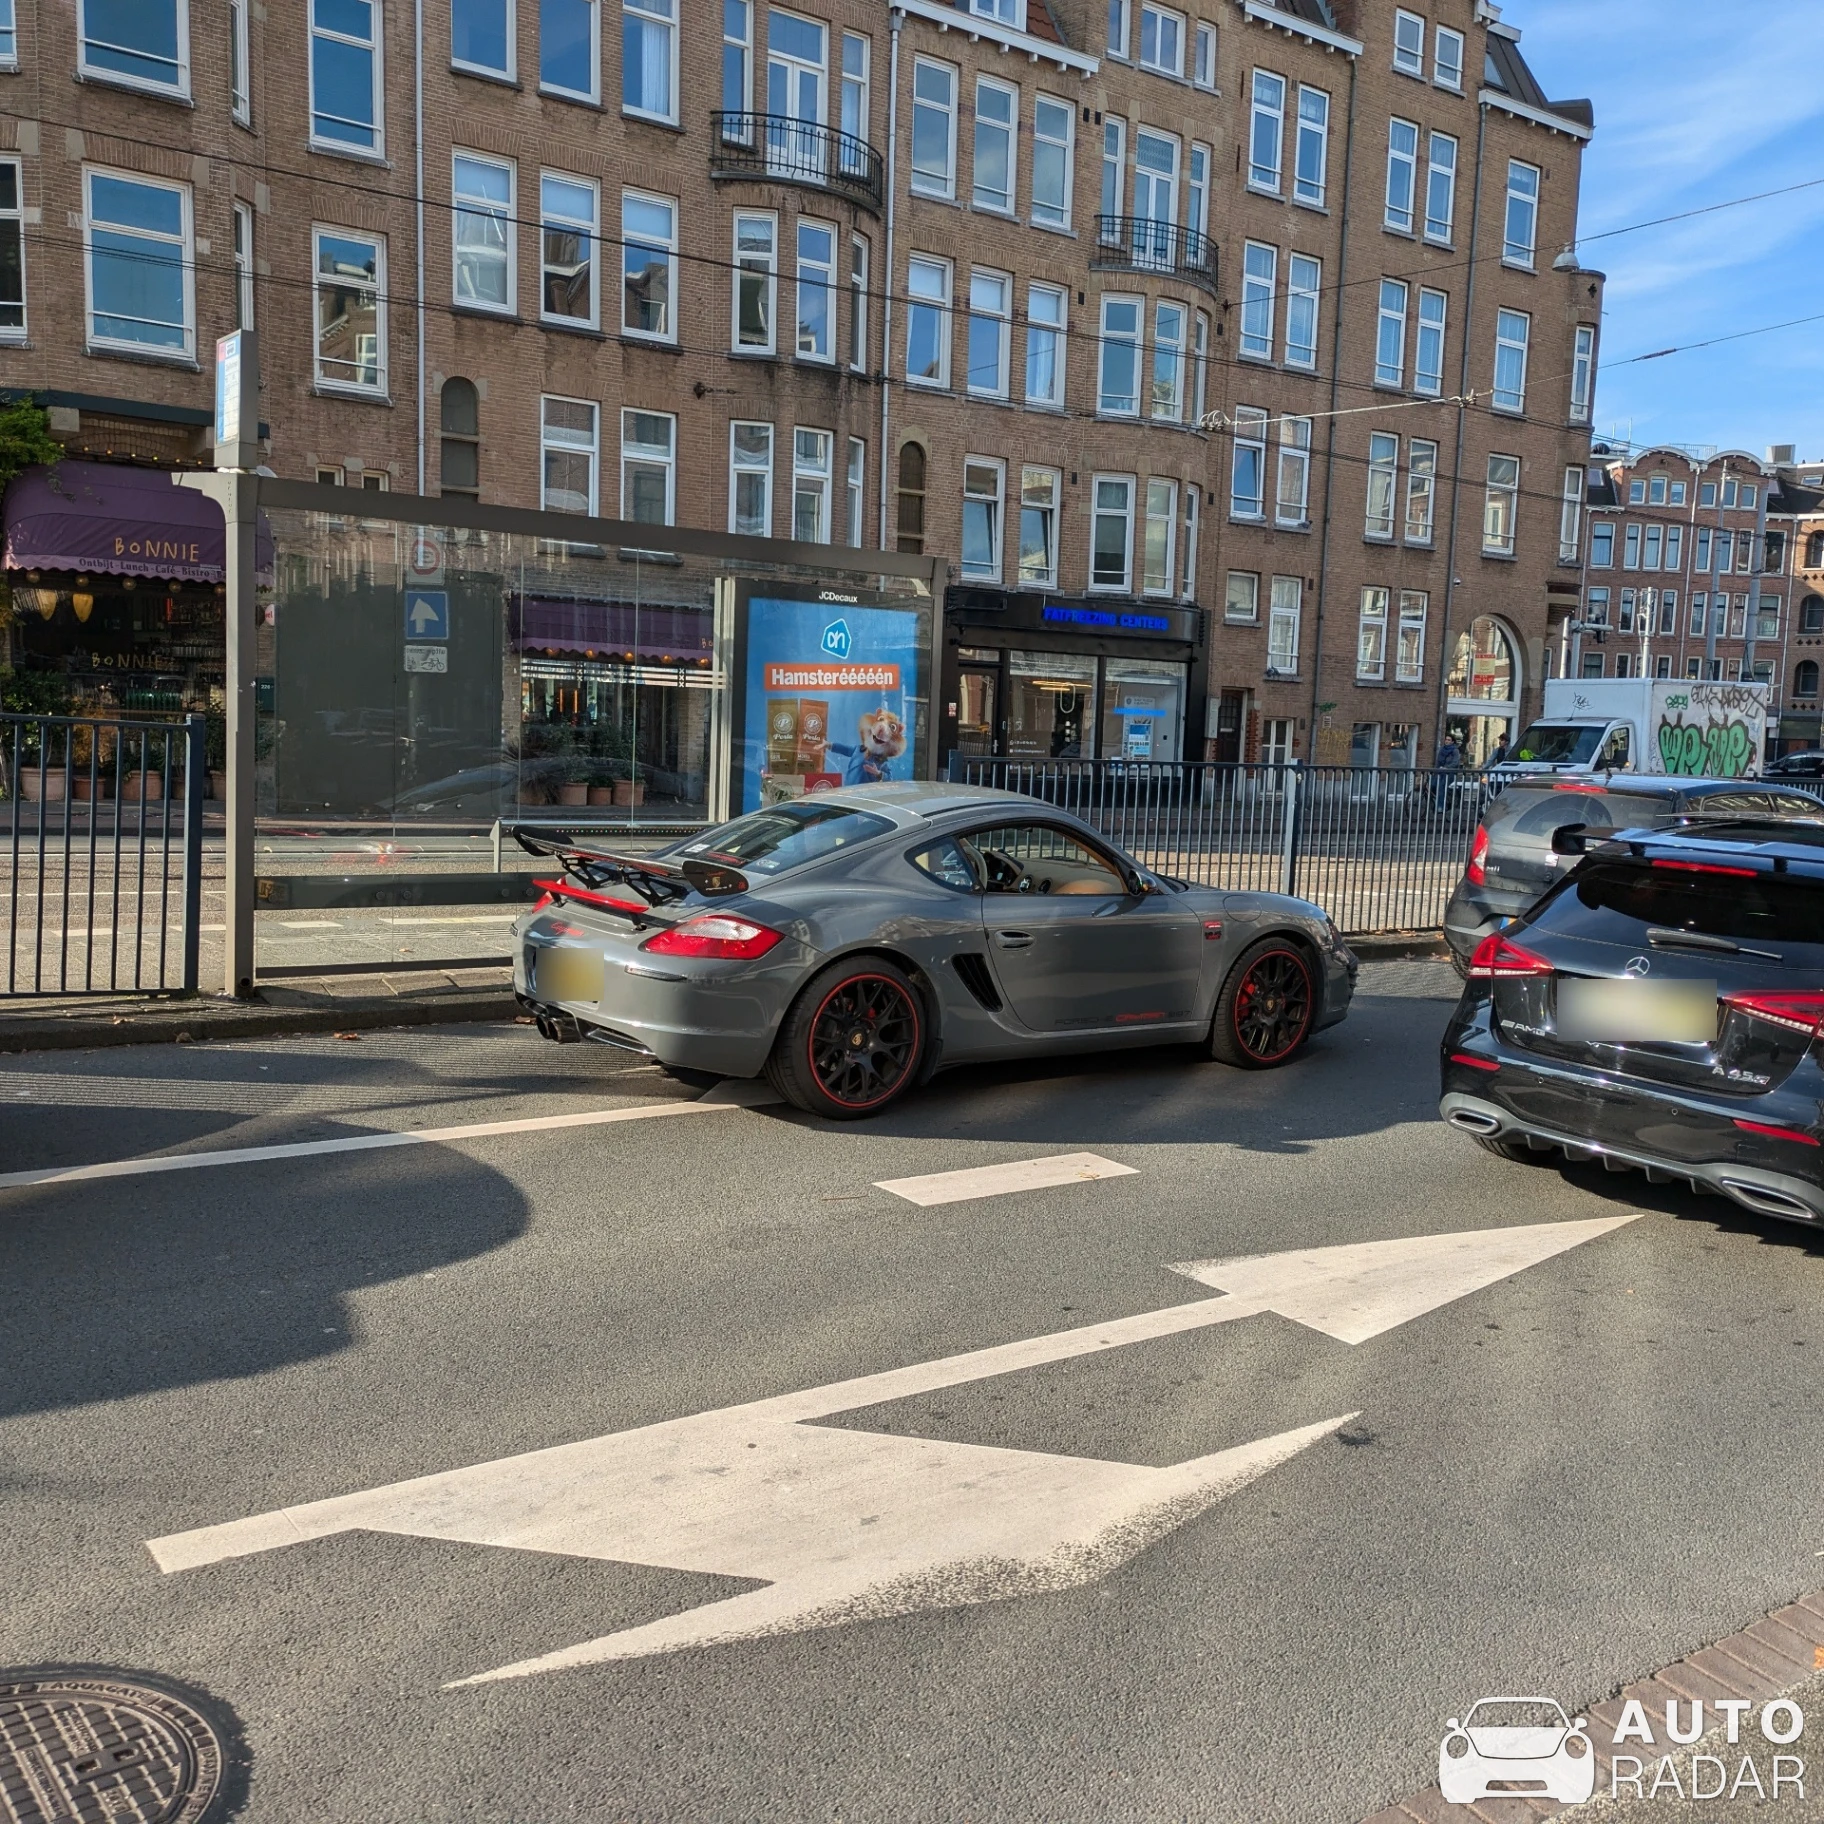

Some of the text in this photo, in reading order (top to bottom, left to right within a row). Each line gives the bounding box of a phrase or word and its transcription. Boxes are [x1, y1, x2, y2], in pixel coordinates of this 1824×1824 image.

[79, 558, 114, 569] Ontbijt
[120, 561, 149, 572] Lunch
[155, 564, 176, 576] Café
[182, 567, 211, 577] Bistro
[819, 591, 858, 603] JCDecaux
[1043, 607, 1169, 631] FATFREEZING CENTERS
[771, 668, 893, 686] Hamsterééééén
[50, 1681, 151, 1700] AQUAGATE
